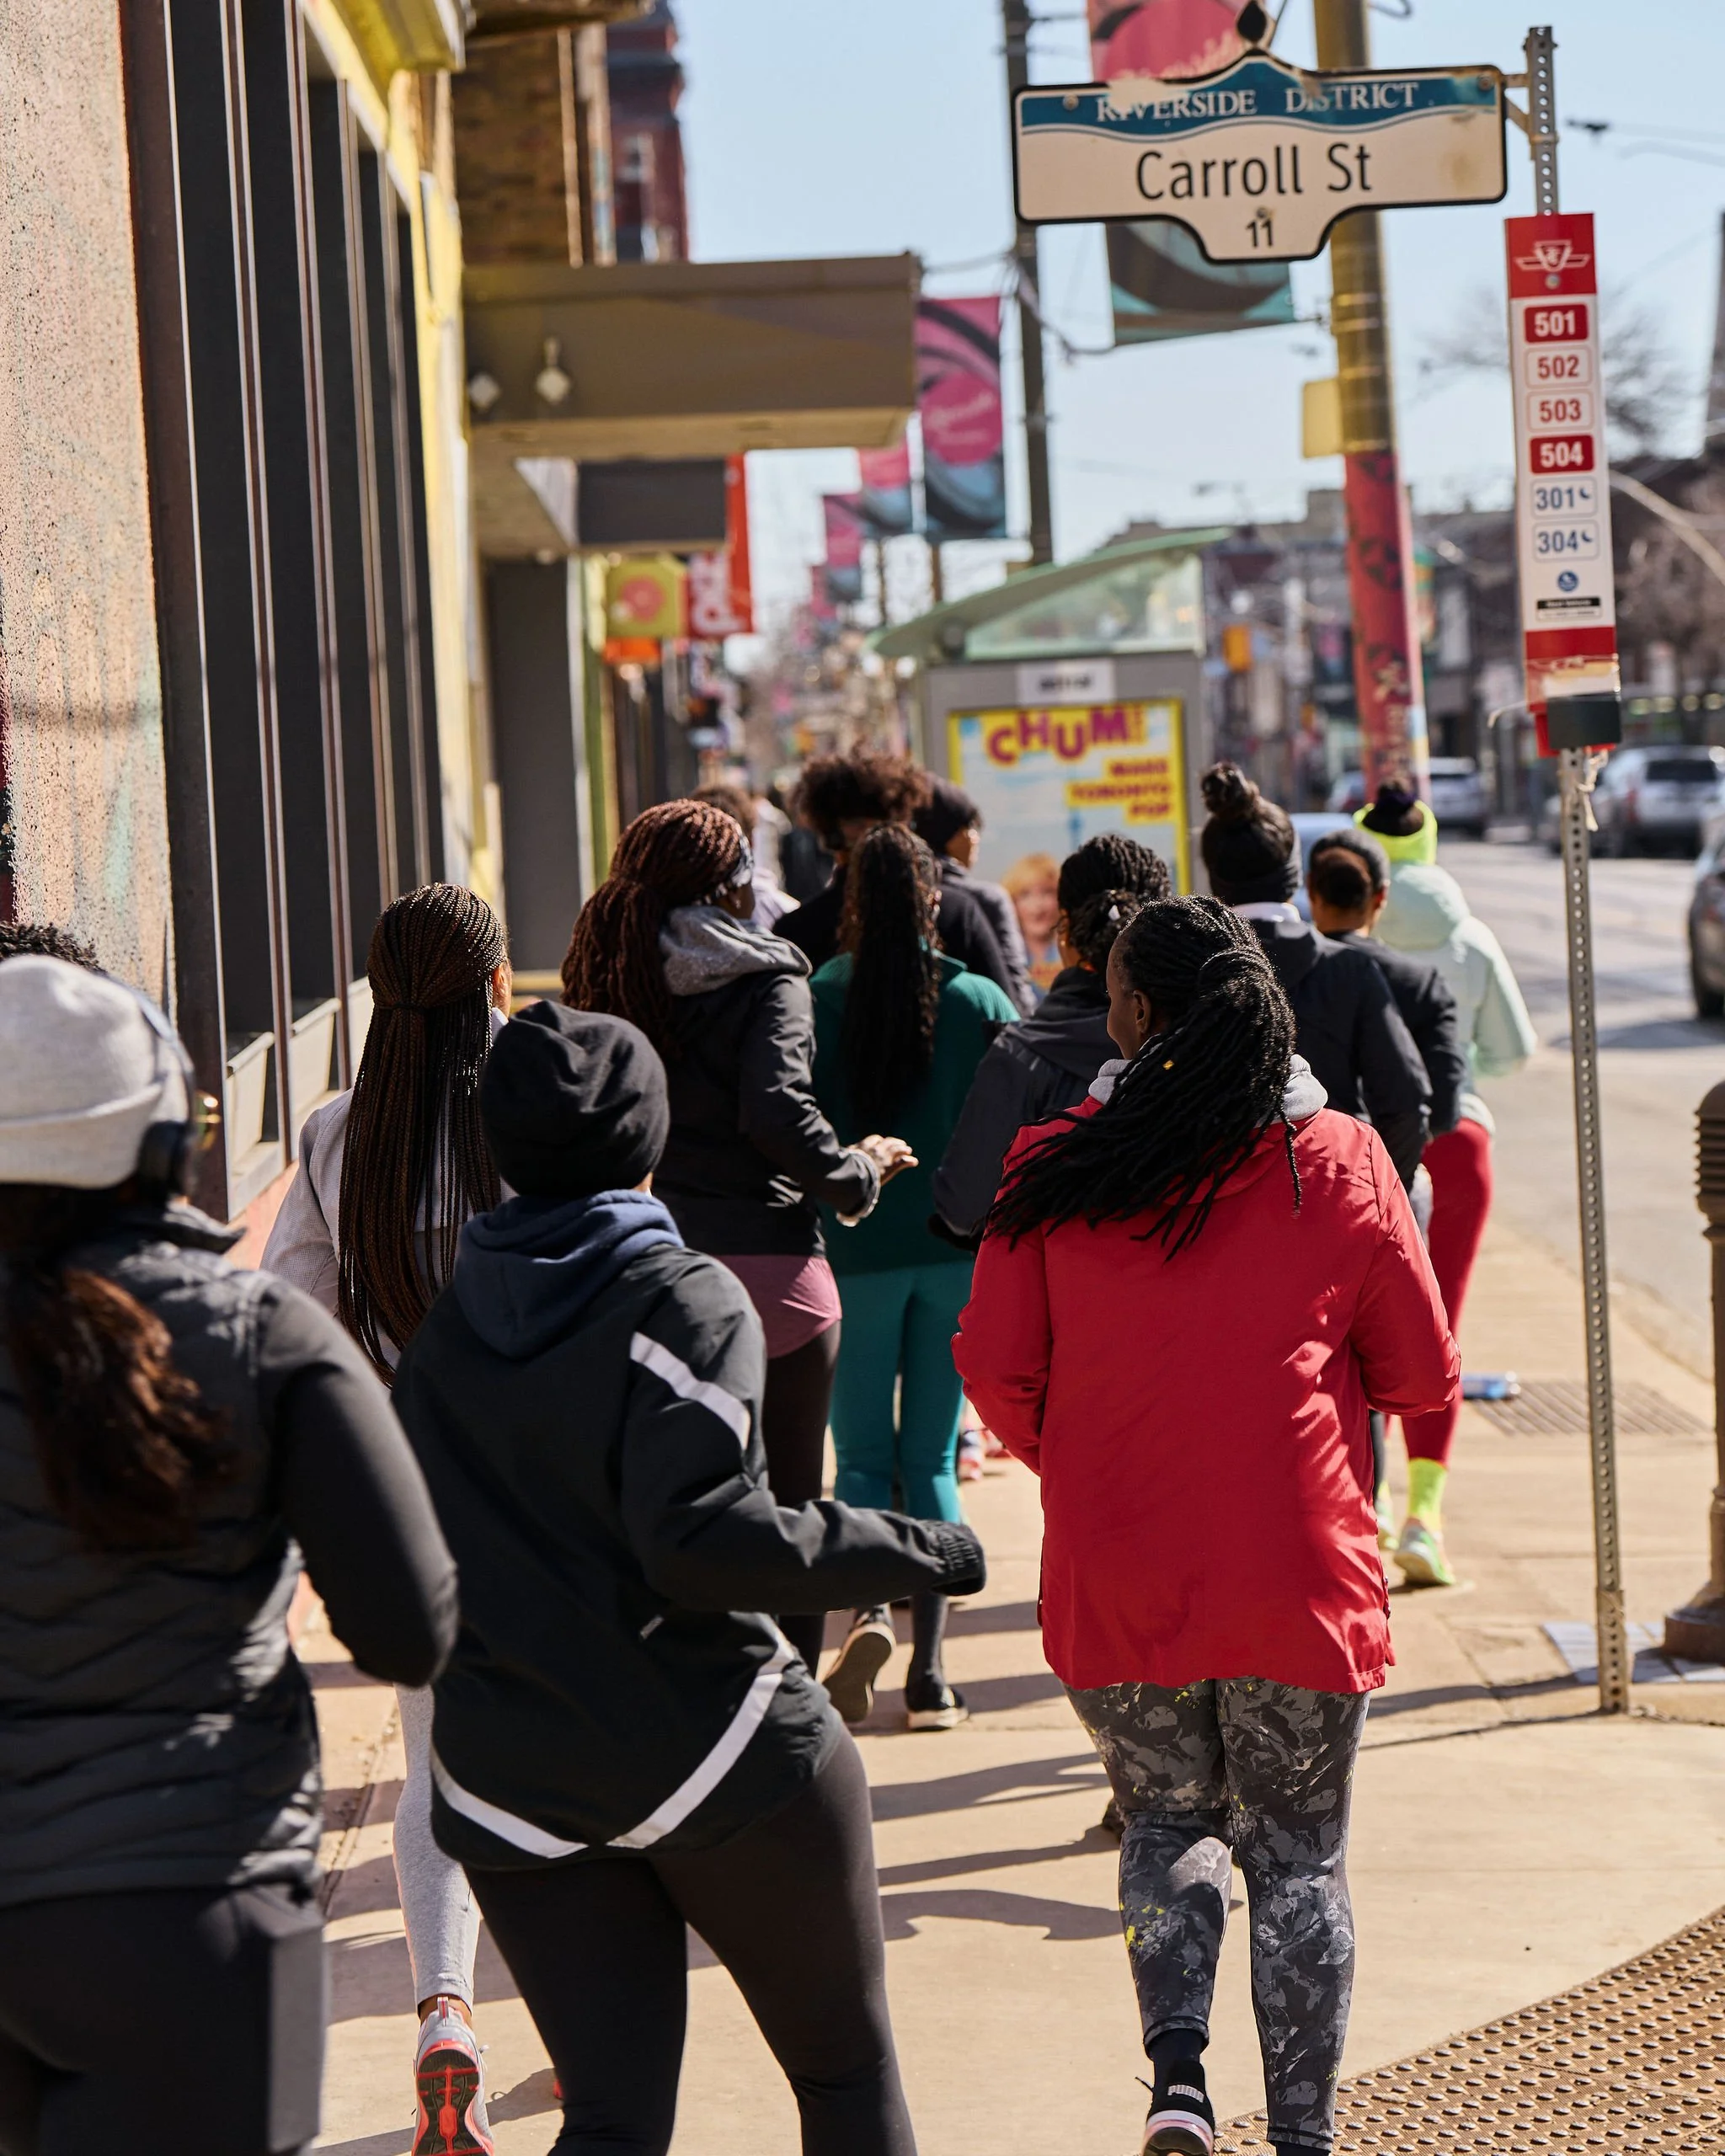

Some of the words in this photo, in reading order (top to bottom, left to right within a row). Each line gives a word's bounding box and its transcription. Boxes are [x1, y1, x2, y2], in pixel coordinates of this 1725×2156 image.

[1284, 82, 1419, 114] DISTRICT
[1136, 144, 1304, 200] Carroll
[1327, 142, 1373, 192] St
[1246, 219, 1275, 248] 11
[1534, 309, 1576, 338] 501
[1537, 355, 1580, 380] 502
[1539, 398, 1582, 424] 503
[1540, 441, 1584, 468] 504
[1535, 488, 1575, 510] 301
[1537, 530, 1579, 554] 304
